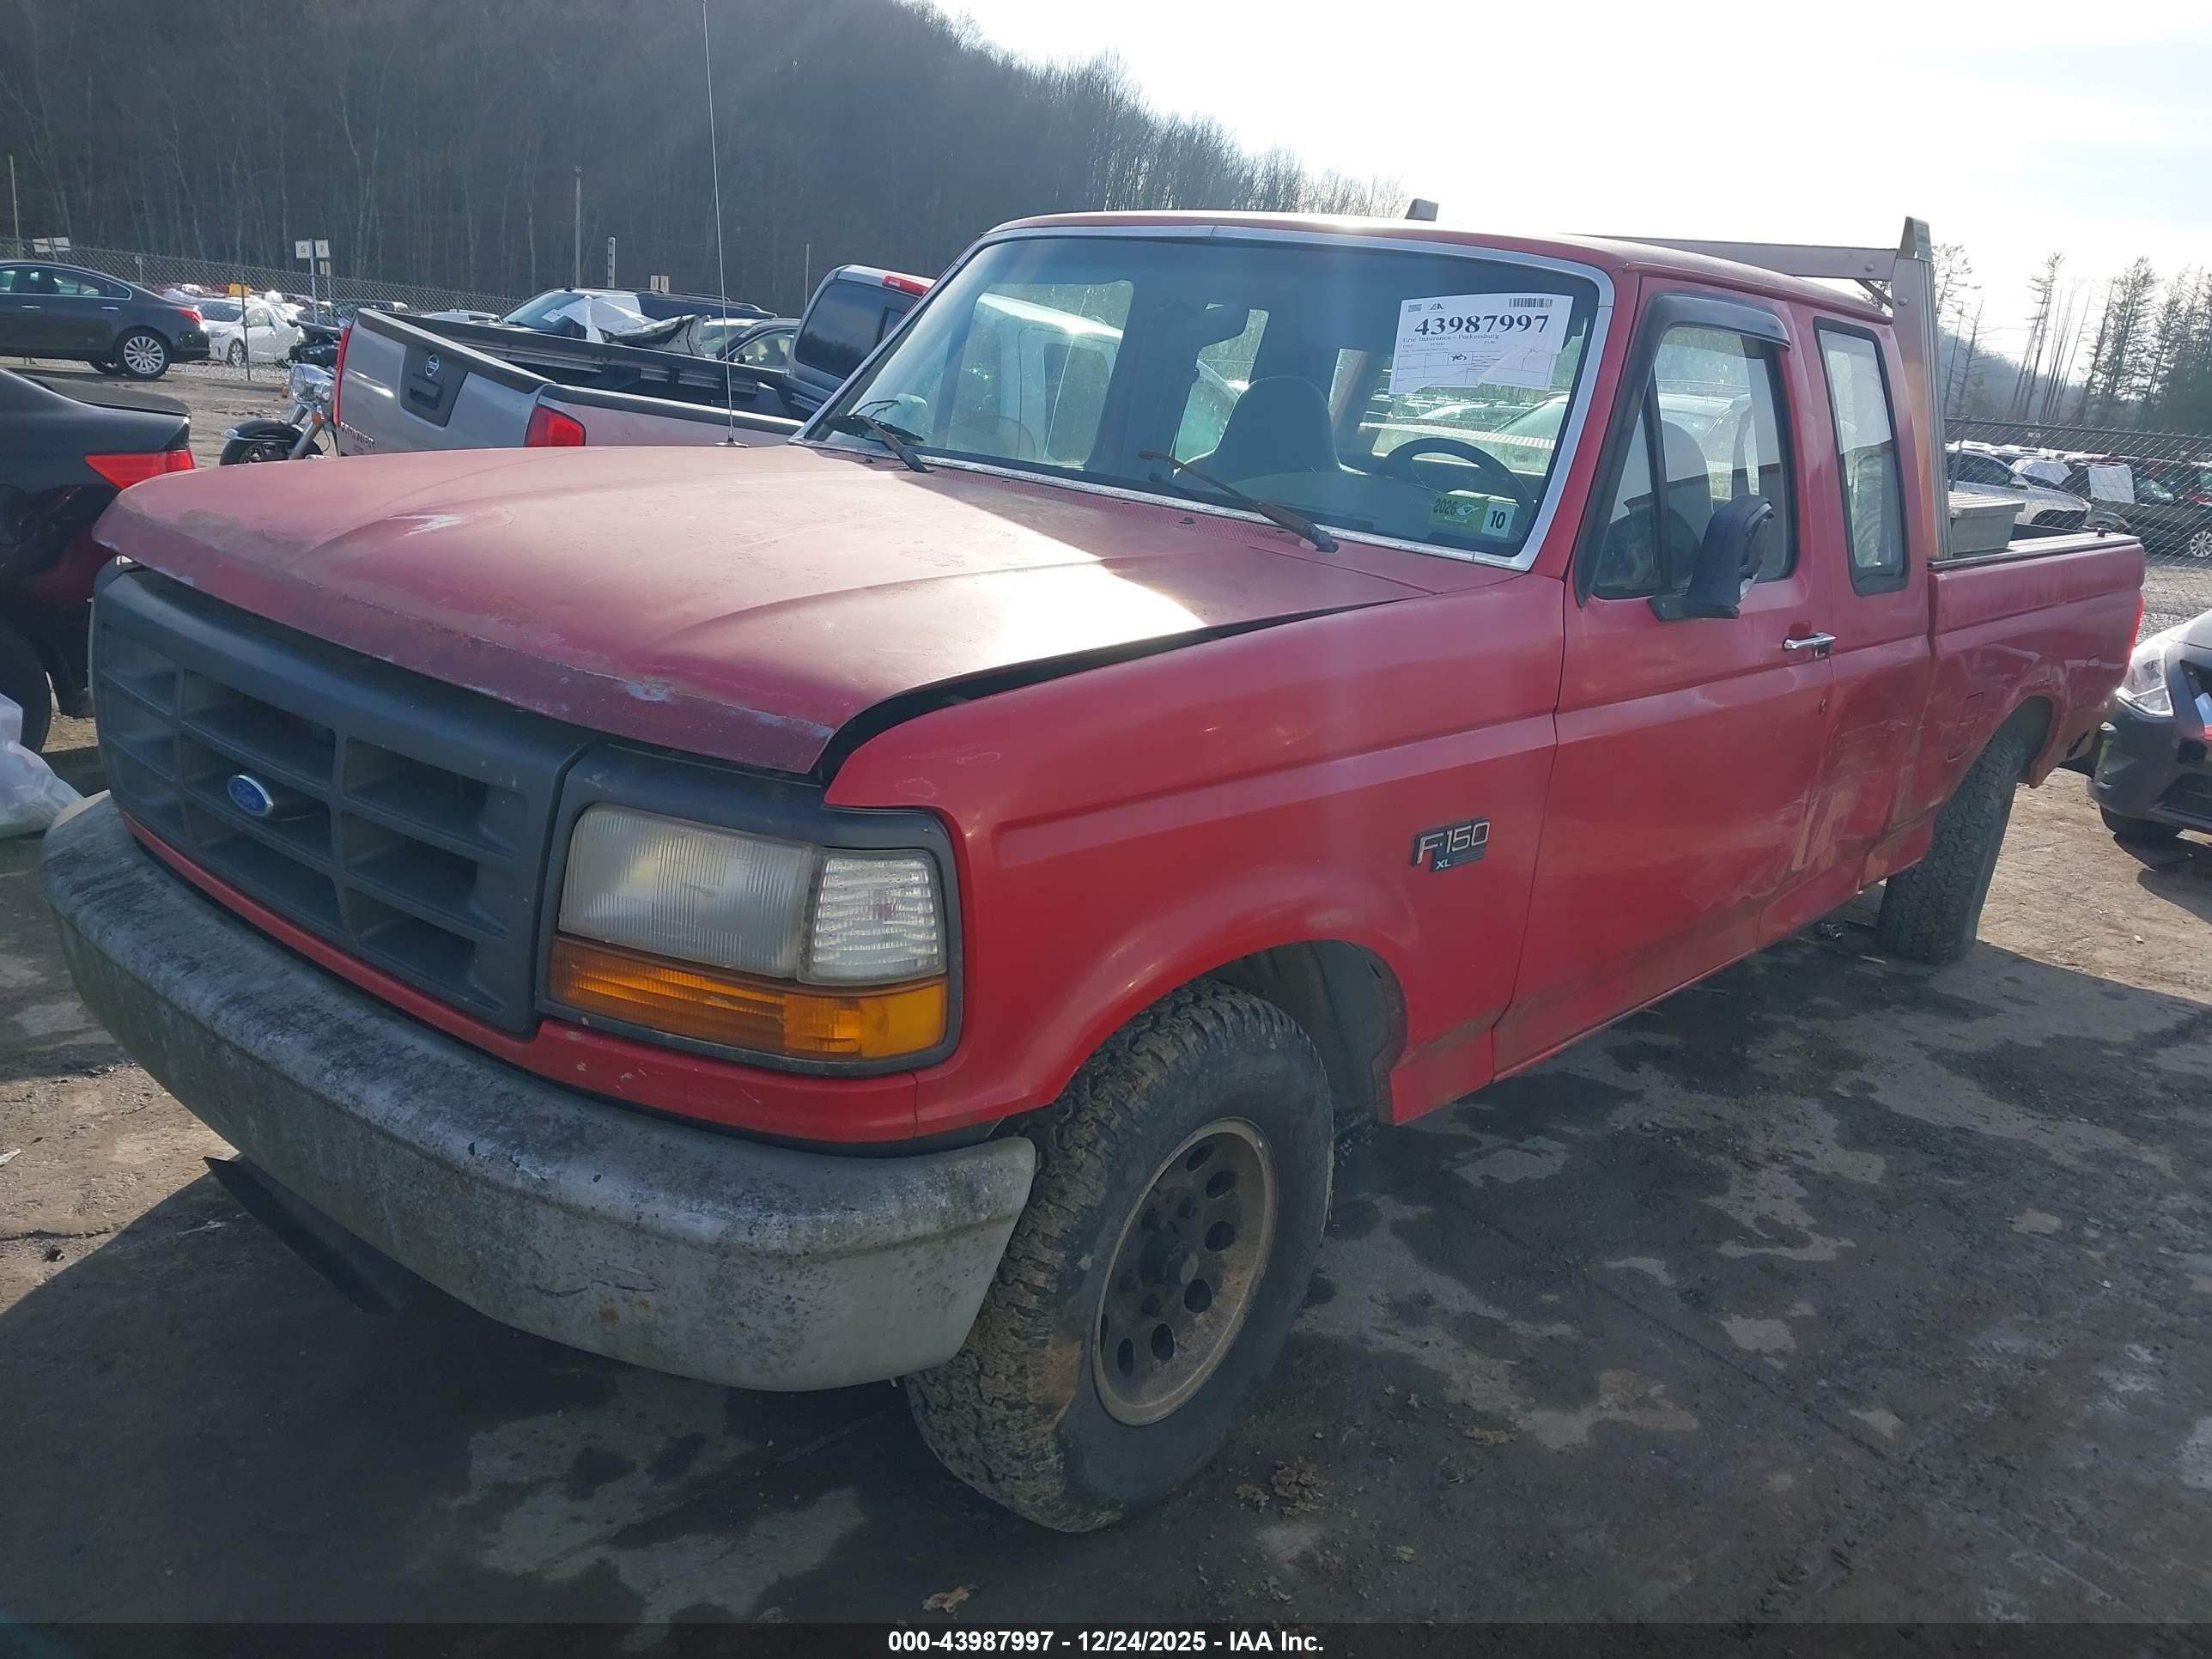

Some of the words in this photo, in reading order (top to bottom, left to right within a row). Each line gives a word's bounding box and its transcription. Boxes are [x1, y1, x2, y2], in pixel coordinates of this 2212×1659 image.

[1414, 314, 1550, 336] 43987997
[1433, 498, 1458, 515] 2026
[1490, 510, 1506, 529] 10
[1436, 859, 1451, 870] XL
